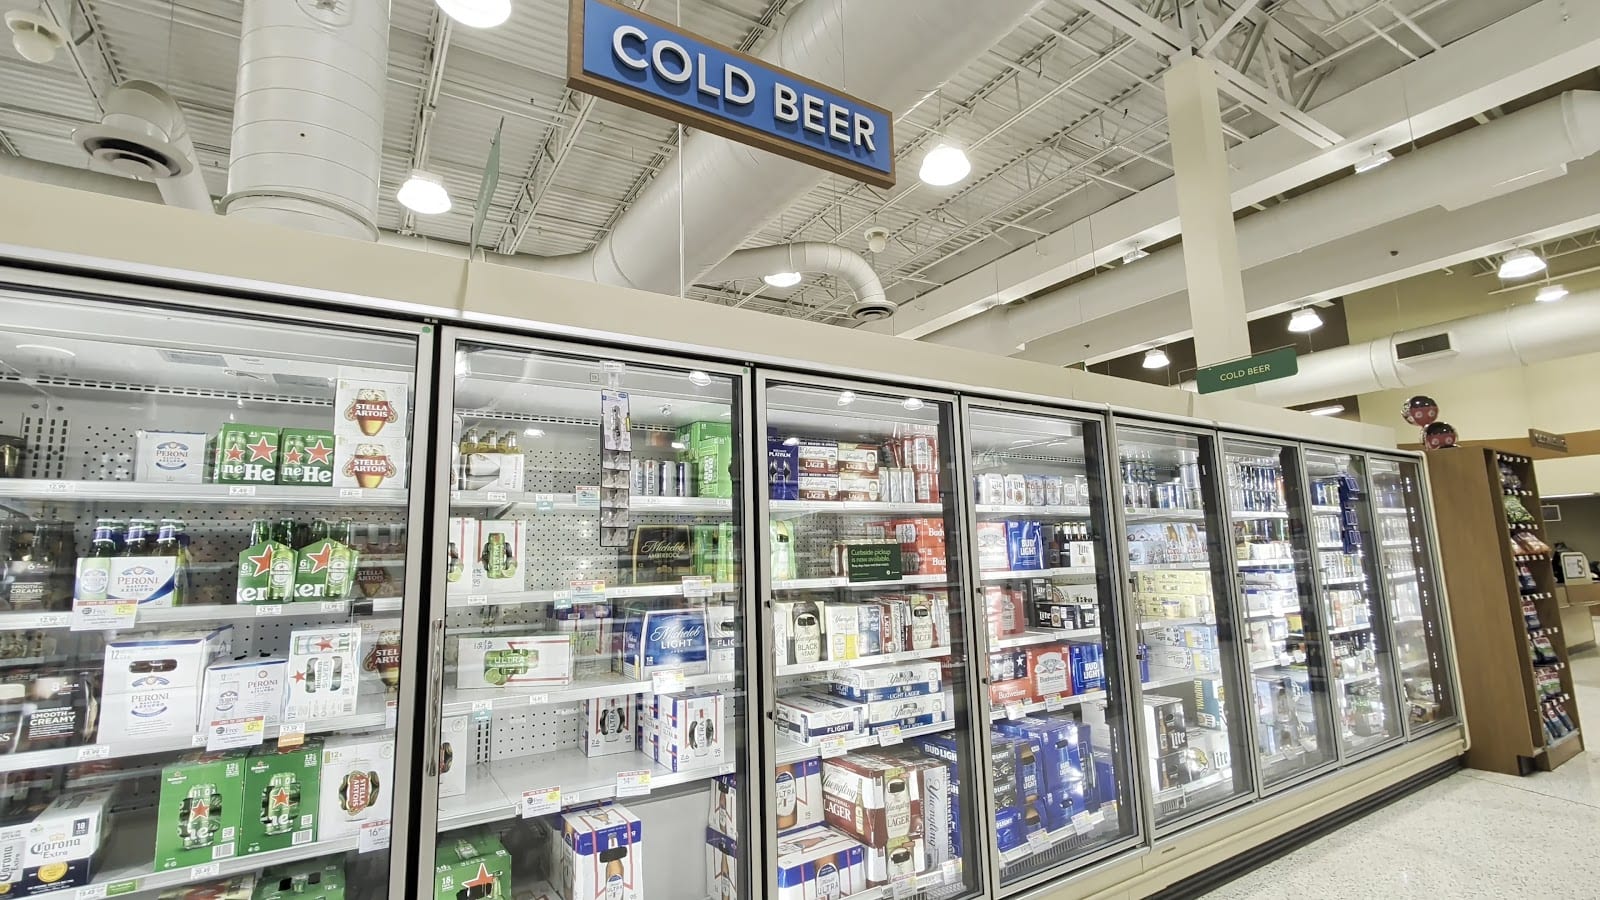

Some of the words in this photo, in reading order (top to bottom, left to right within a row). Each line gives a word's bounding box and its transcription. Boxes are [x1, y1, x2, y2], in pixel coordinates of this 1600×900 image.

[612, 25, 756, 105] COLD
[774, 82, 876, 153] BEER
[1219, 370, 1245, 381] COLD
[1247, 363, 1271, 375] BEER
[355, 403, 388, 411] STELLA
[354, 410, 388, 418] ARTOIS
[156, 450, 189, 458] PERONI
[805, 460, 825, 469] LAGER
[1577, 559, 1584, 575] 5
[117, 576, 159, 585] PERONI
[1039, 611, 1051, 620] Lite
[650, 625, 703, 642] Michelob
[661, 638, 693, 649] LIGHT
[797, 643, 818, 651] BLACK
[494, 656, 526, 664] ULTRA
[1084, 662, 1098, 671] BUD
[247, 679, 278, 688] PERONI
[131, 692, 169, 703] PERONI
[998, 689, 1026, 699] Budweiser
[29, 715, 76, 726] CREAMY
[31, 711, 67, 719] SMOOTH
[827, 724, 849, 733] FLIGHT
[1170, 731, 1186, 749] Lite
[924, 744, 940, 758] BUD
[822, 769, 857, 800] Yuengling
[824, 799, 852, 822] LAGER
[926, 778, 941, 851] Yuengling
[887, 814, 910, 828] LAGER
[30, 838, 81, 855] Corona
[43, 851, 68, 859] Extra
[817, 884, 839, 895] ULTRA
